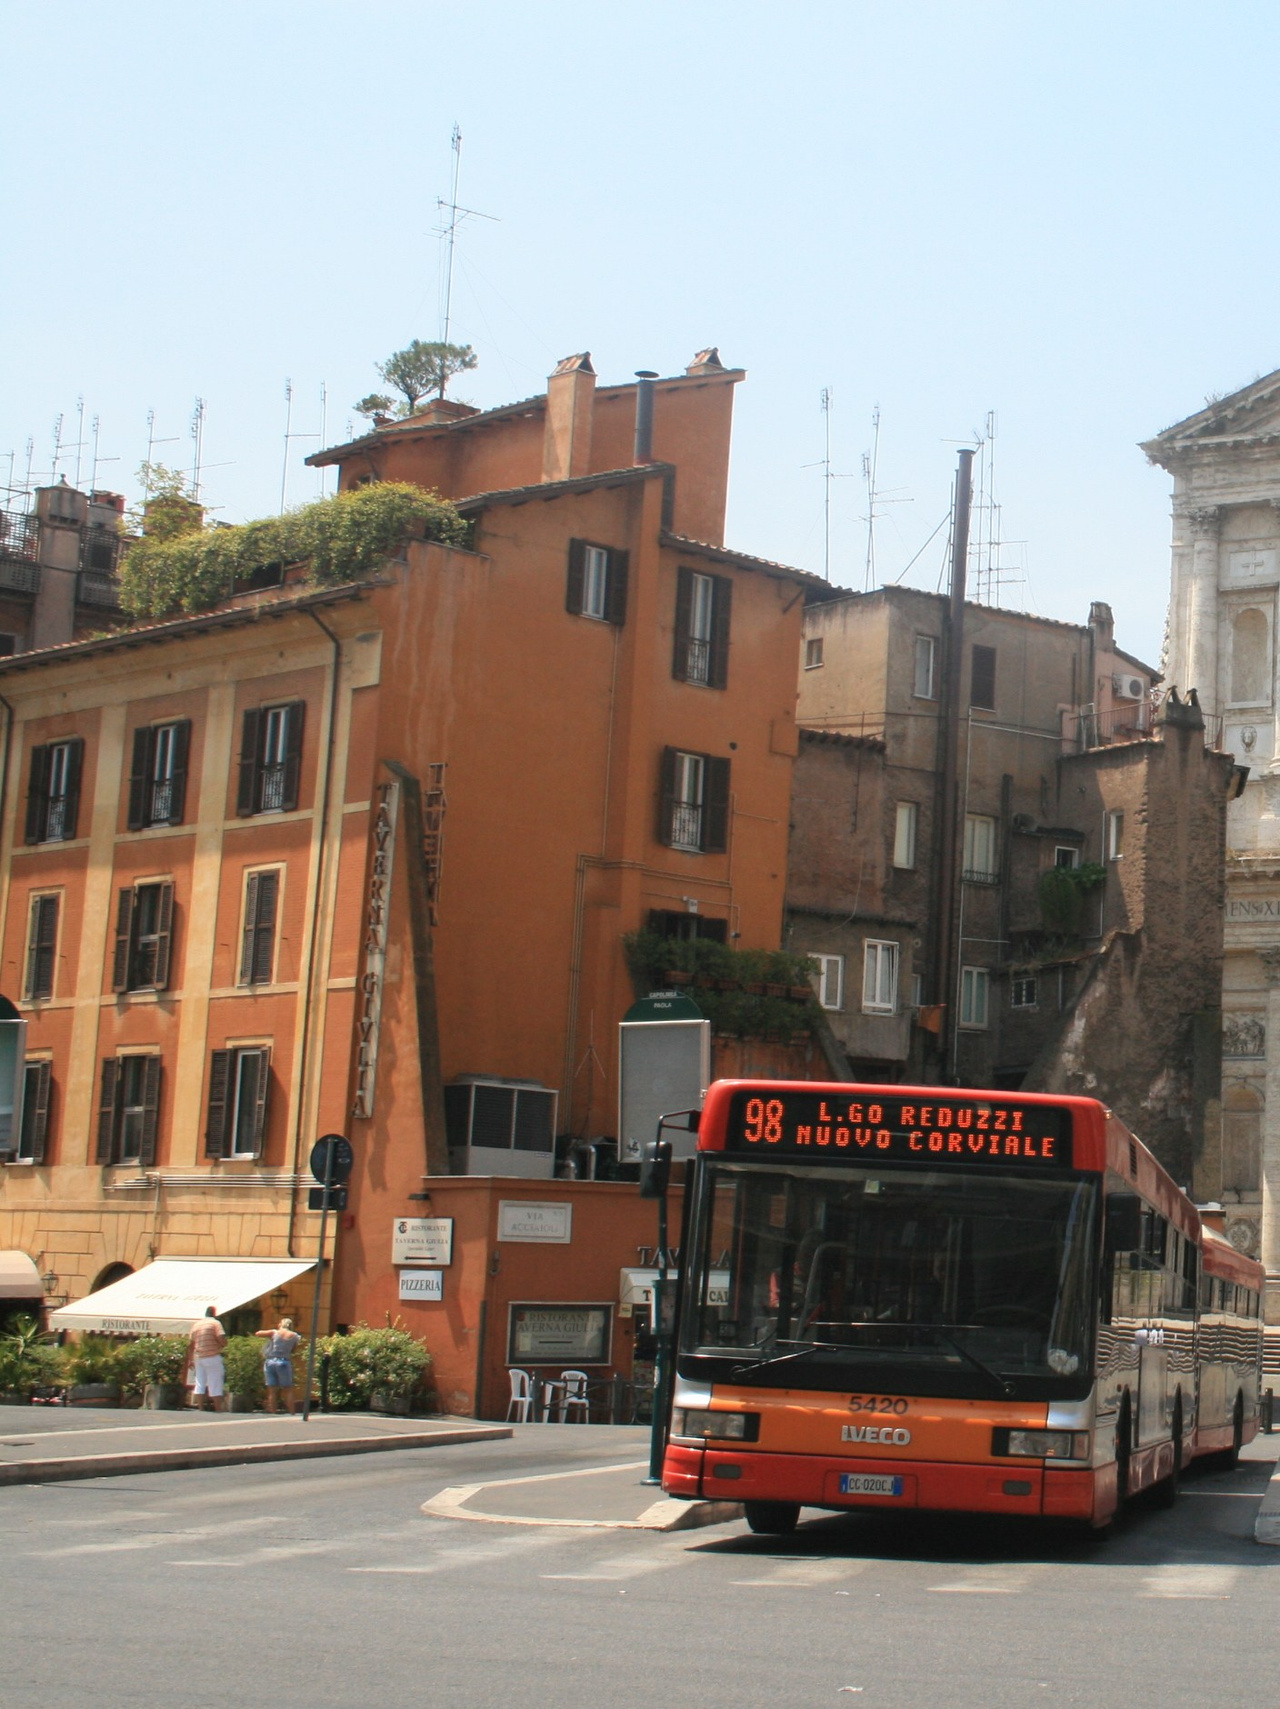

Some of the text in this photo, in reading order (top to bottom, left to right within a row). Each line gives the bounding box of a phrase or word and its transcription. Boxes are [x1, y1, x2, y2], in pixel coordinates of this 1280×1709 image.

[365, 783, 393, 949] TAVERNA
[745, 1098, 784, 1143] 98
[819, 1102, 1024, 1131] L.GO REDUZZI
[796, 1125, 1055, 1157] NUOVO CORVIALE
[526, 1212, 543, 1220] VIA
[400, 1279, 441, 1291] PIZZERIA
[101, 1318, 151, 1331] RISTORANTE
[517, 1322, 561, 1333] AVERNA
[849, 1396, 908, 1415] 5420
[841, 1425, 911, 1446] IVECO
